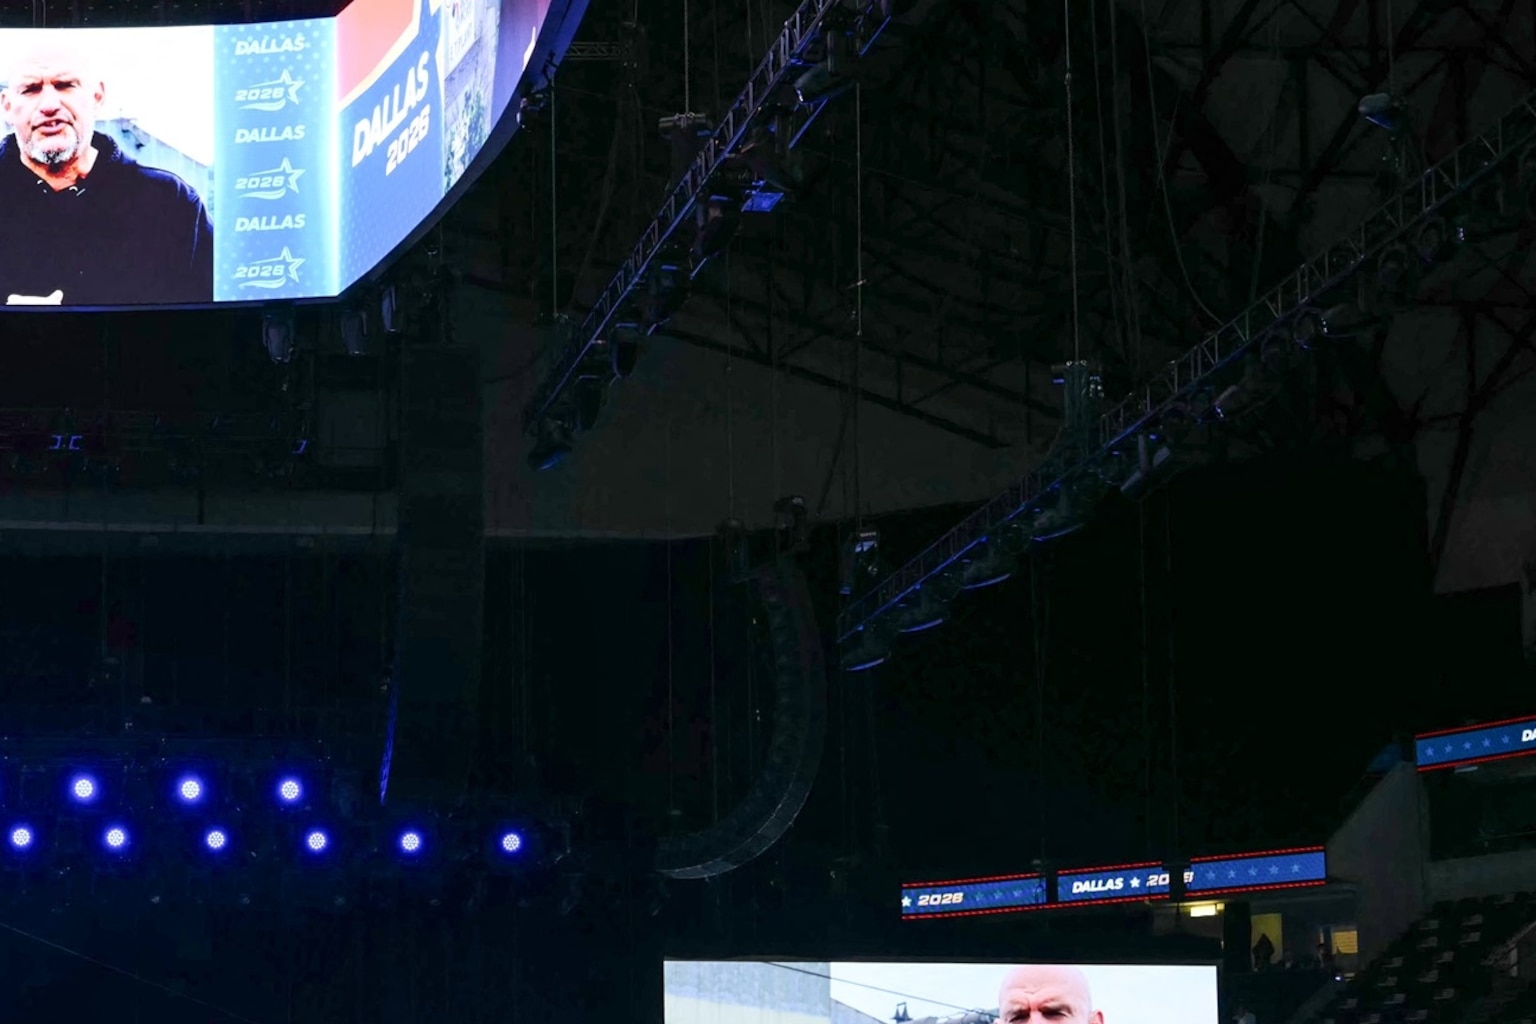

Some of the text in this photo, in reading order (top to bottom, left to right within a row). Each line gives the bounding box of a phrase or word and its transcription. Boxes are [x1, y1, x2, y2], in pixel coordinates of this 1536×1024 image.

[234, 36, 305, 56] DALLAS
[234, 87, 285, 102] 2026
[352, 50, 429, 168] DALLAS
[234, 125, 306, 144] DALLAS
[385, 103, 430, 177] 2026
[234, 176, 285, 190] 2026
[234, 213, 306, 232] DALLAS
[234, 264, 285, 279] 2026
[1071, 877, 1124, 894] DALLAS
[917, 892, 964, 906] 2026
